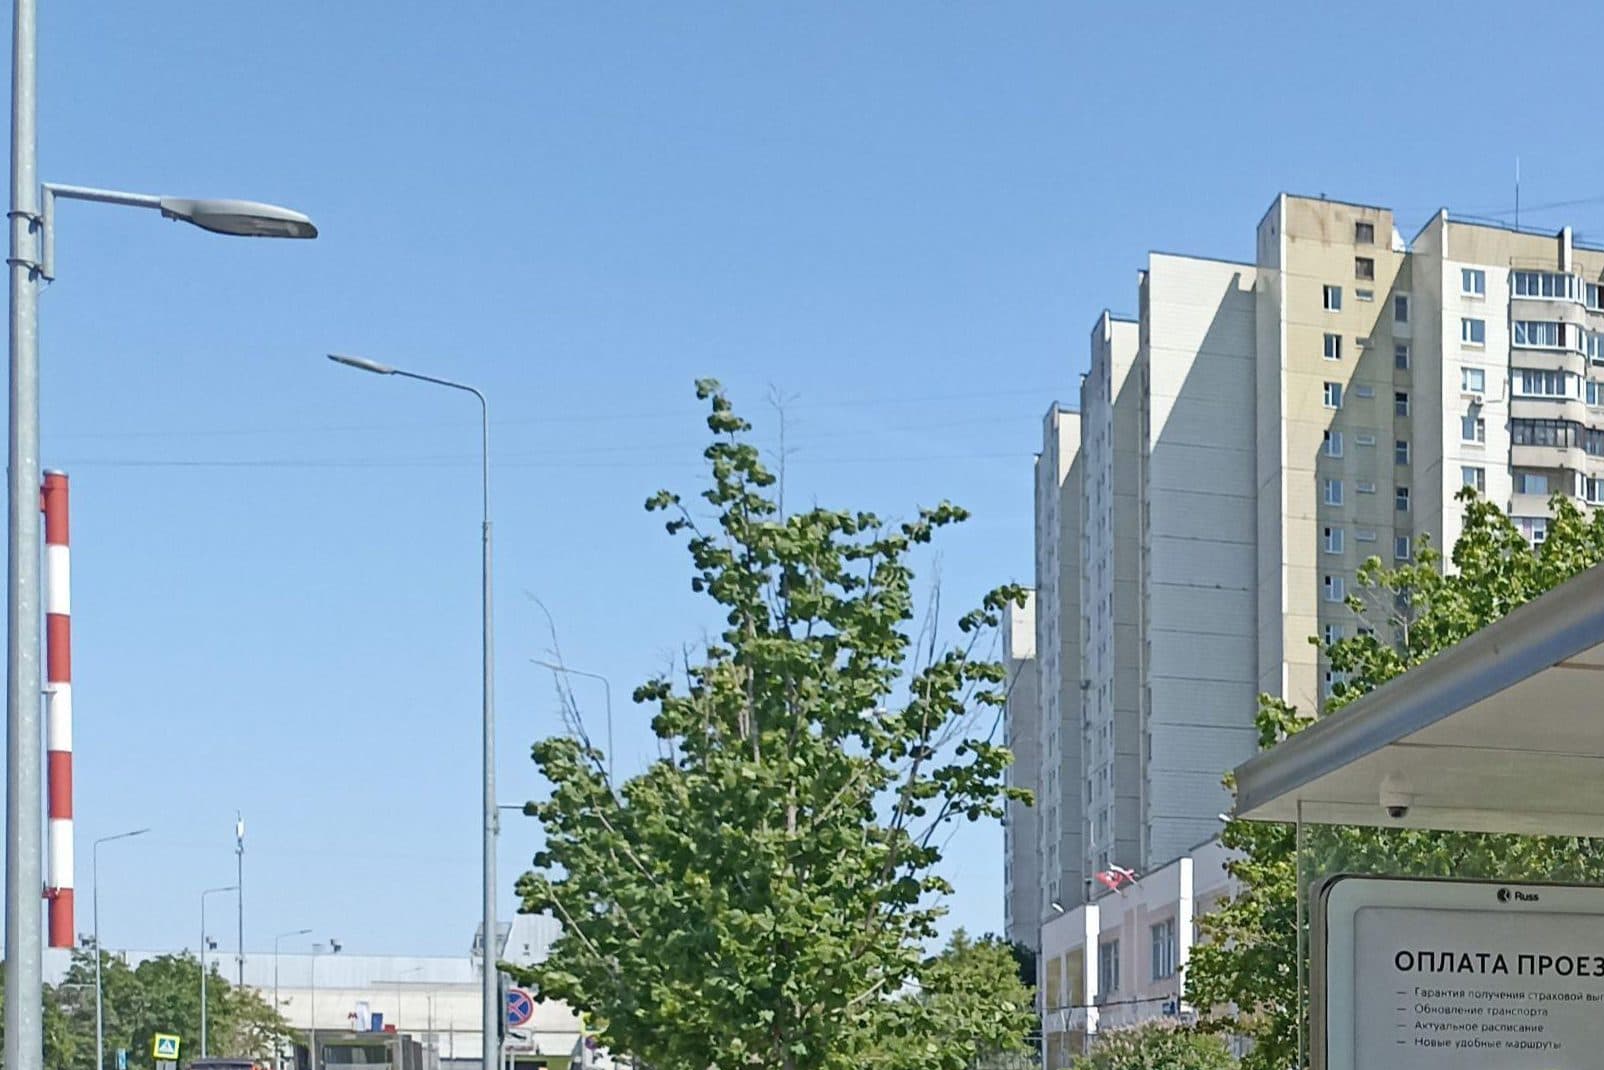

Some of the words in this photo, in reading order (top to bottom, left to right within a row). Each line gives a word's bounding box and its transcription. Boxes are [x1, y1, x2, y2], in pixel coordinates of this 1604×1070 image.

[1514, 891, 1539, 901] Russ
[1394, 951, 1508, 974] ОПЛАТА
[1414, 986, 1465, 999] Гарантия
[1468, 990, 1526, 1001] получения
[1527, 992, 1584, 1002] страховой
[1414, 1003, 1484, 1015] Обновление
[1487, 1007, 1548, 1017] транспорта
[1414, 1020, 1479, 1032] Актуальное
[1481, 1022, 1544, 1033] расписание
[1414, 1037, 1452, 1048] Новые
[1455, 1037, 1502, 1049] удобные
[1505, 1040, 1562, 1051] маршруты
